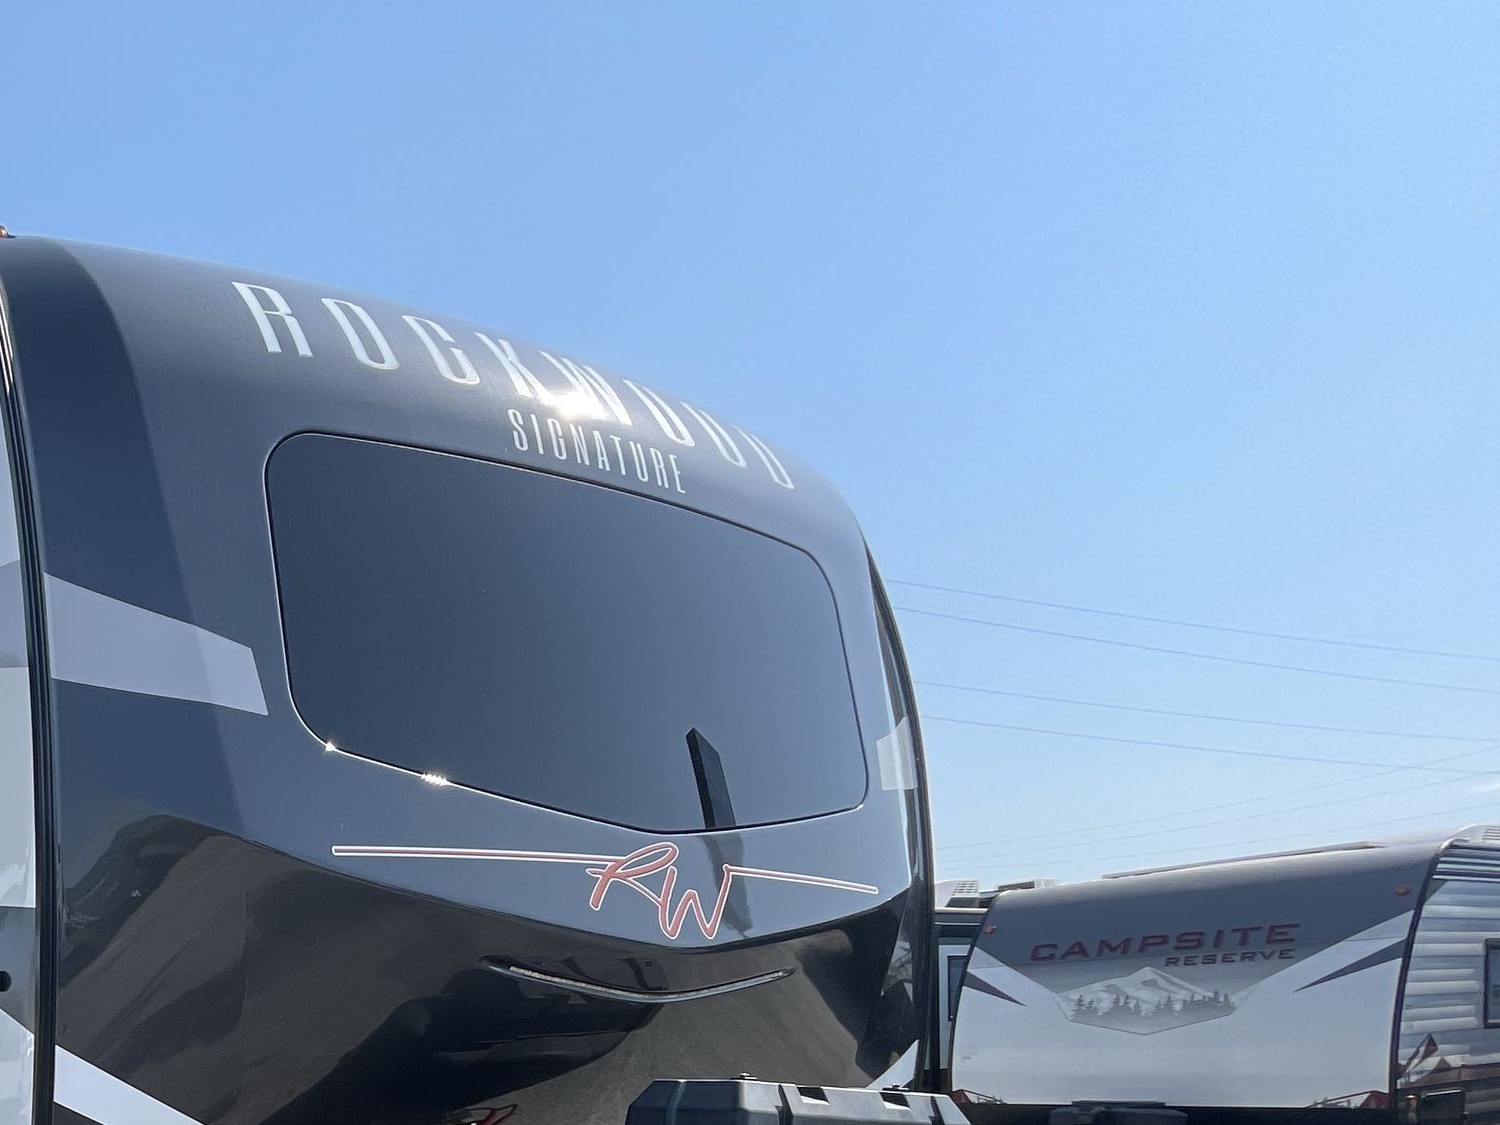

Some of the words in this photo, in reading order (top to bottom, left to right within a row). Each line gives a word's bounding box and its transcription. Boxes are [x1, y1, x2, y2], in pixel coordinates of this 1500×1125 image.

[231, 280, 796, 490] ROCKWOOD
[507, 407, 687, 495] SIGNATURE
[1029, 922, 1301, 962] CAMPSITE
[1164, 948, 1296, 968] RESERVE
